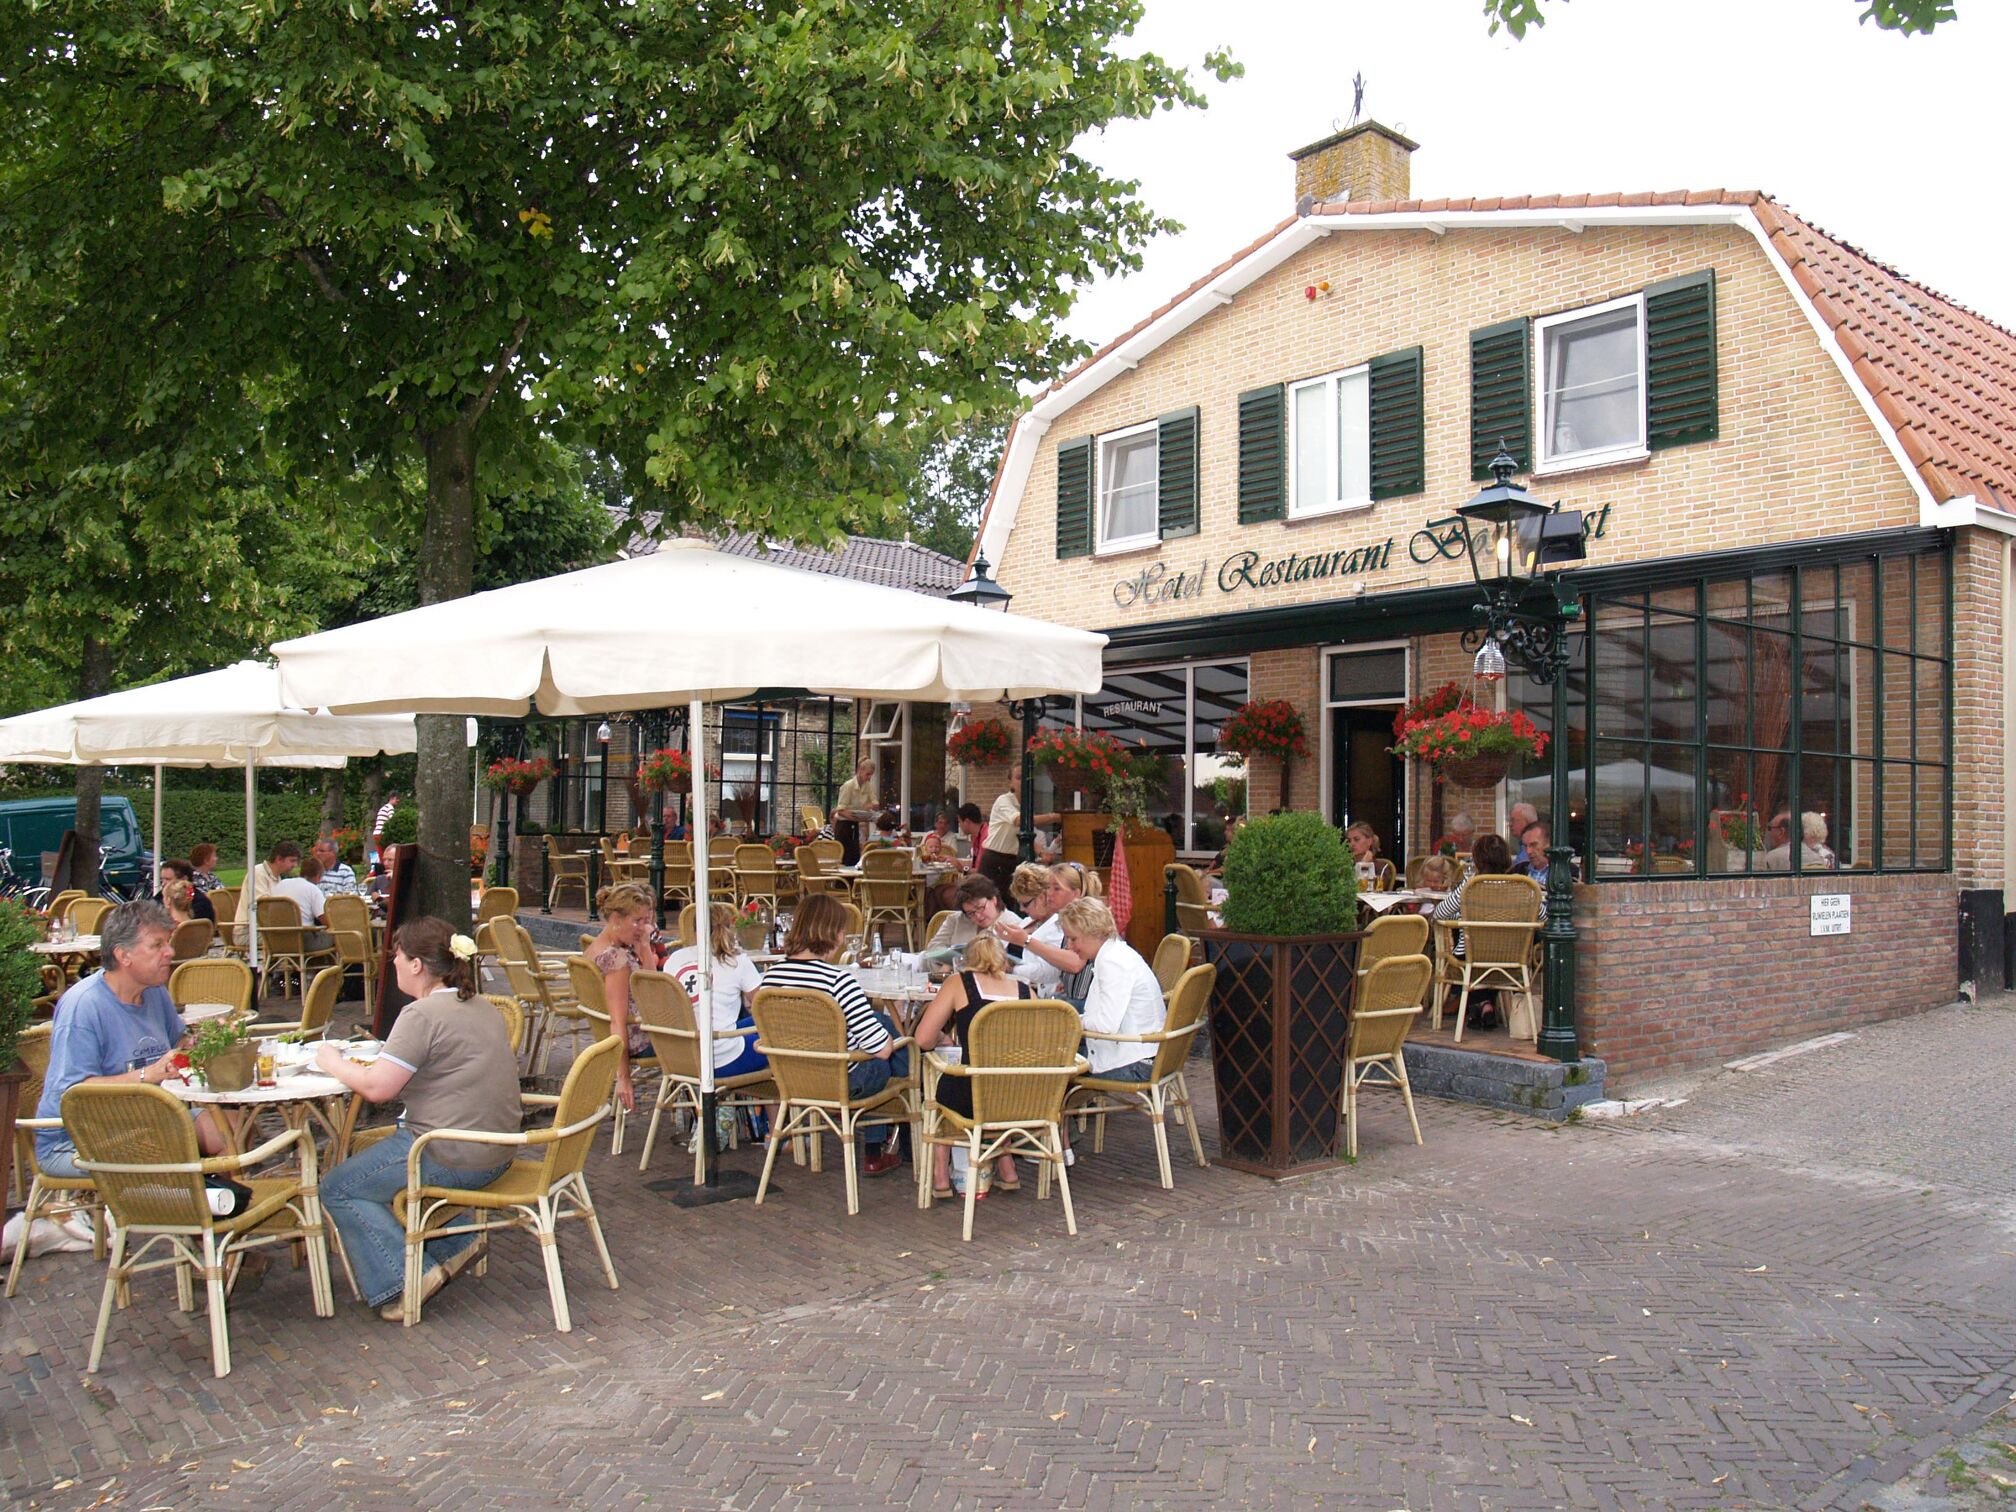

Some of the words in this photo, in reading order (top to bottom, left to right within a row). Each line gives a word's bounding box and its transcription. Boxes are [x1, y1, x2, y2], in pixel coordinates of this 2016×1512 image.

[1113, 558, 1207, 608] Hotel
[1217, 537, 1395, 593] Restaurant
[1103, 700, 1162, 717] RESTAURANT
